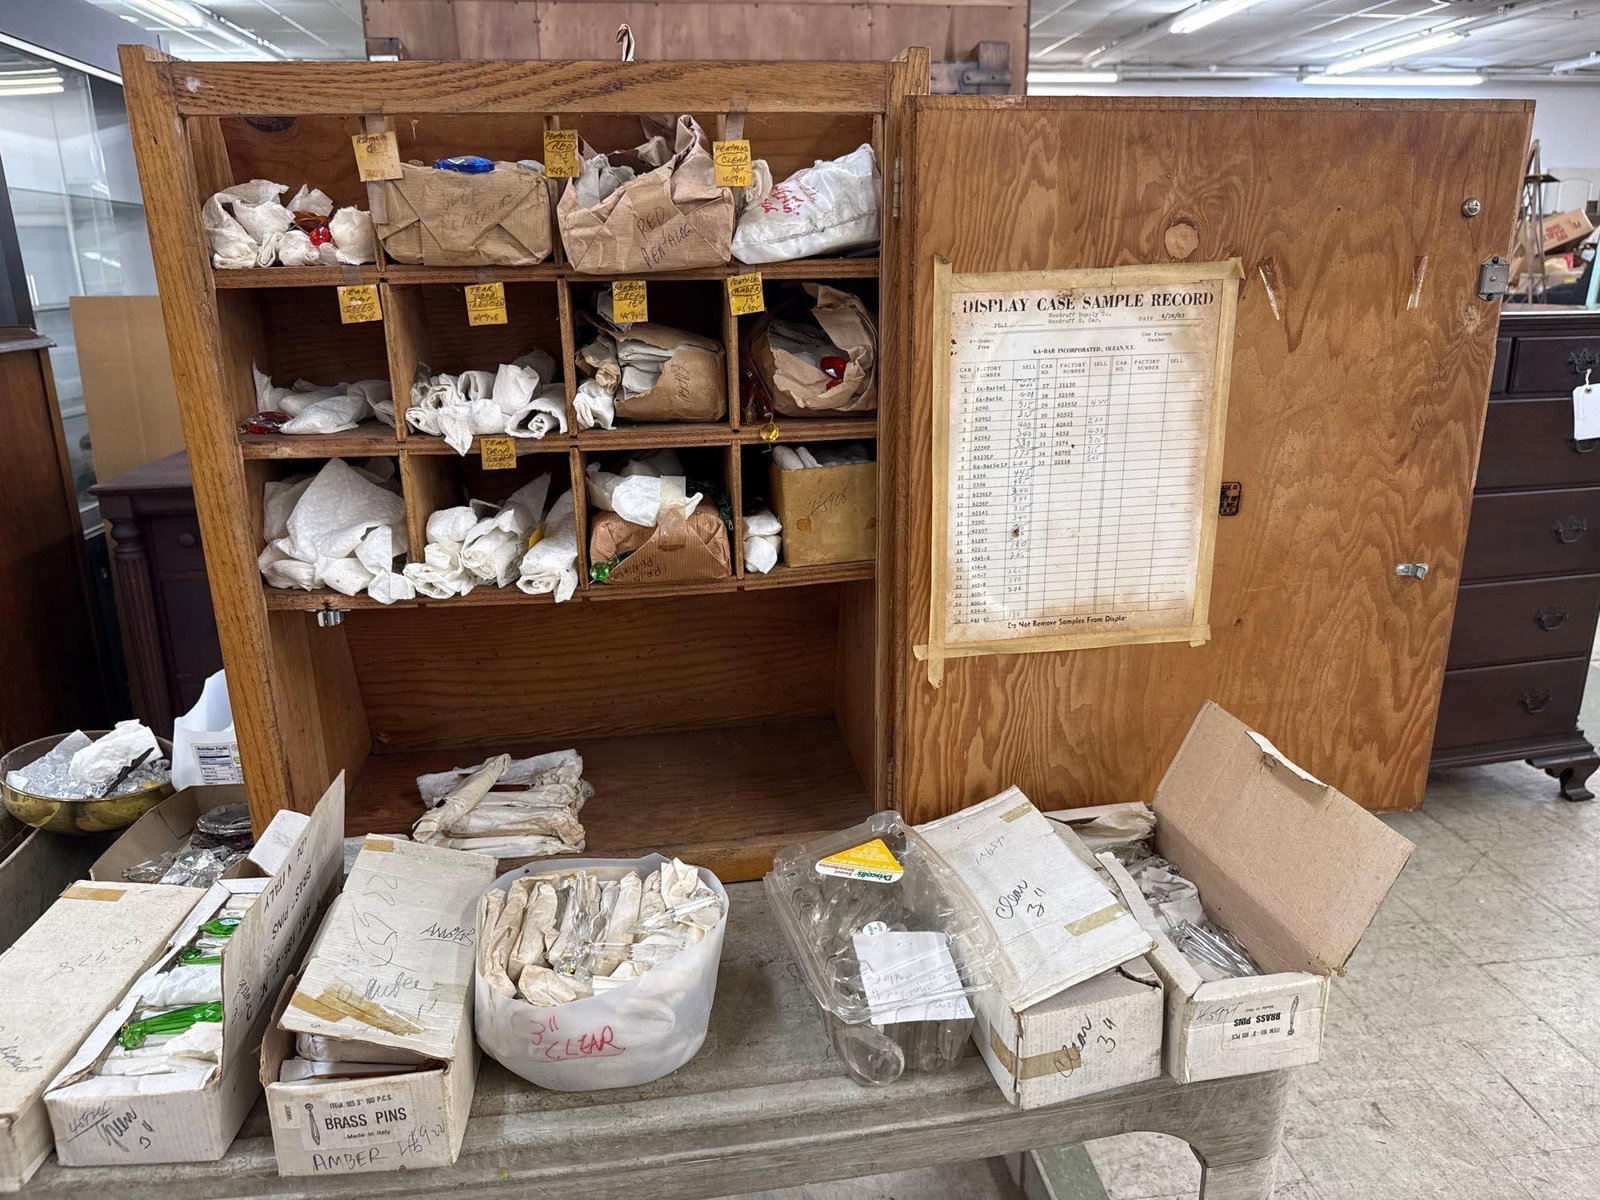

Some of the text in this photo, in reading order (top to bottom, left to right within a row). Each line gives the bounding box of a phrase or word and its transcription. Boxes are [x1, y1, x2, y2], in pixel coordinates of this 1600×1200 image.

[552, 142, 573, 151] RED
[636, 206, 667, 241] RED
[469, 286, 494, 294] TEAR
[963, 292, 1214, 314] DISPLAY CASE SAMPLE RECORD
[1019, 620, 1031, 628] Not
[1032, 619, 1057, 627] Remove
[1059, 617, 1085, 625] Samples
[857, 871, 892, 881] Driscoll's
[270, 910, 290, 942] PINS
[1233, 1012, 1281, 1027] BRASS PINS
[545, 1025, 627, 1062] CLEAR
[376, 1094, 394, 1103] P.C.S.
[324, 1107, 408, 1131] BRASS PINS
[346, 1132, 366, 1140] Made
[376, 1129, 392, 1138] Italy
[312, 1146, 390, 1172] AMBER
